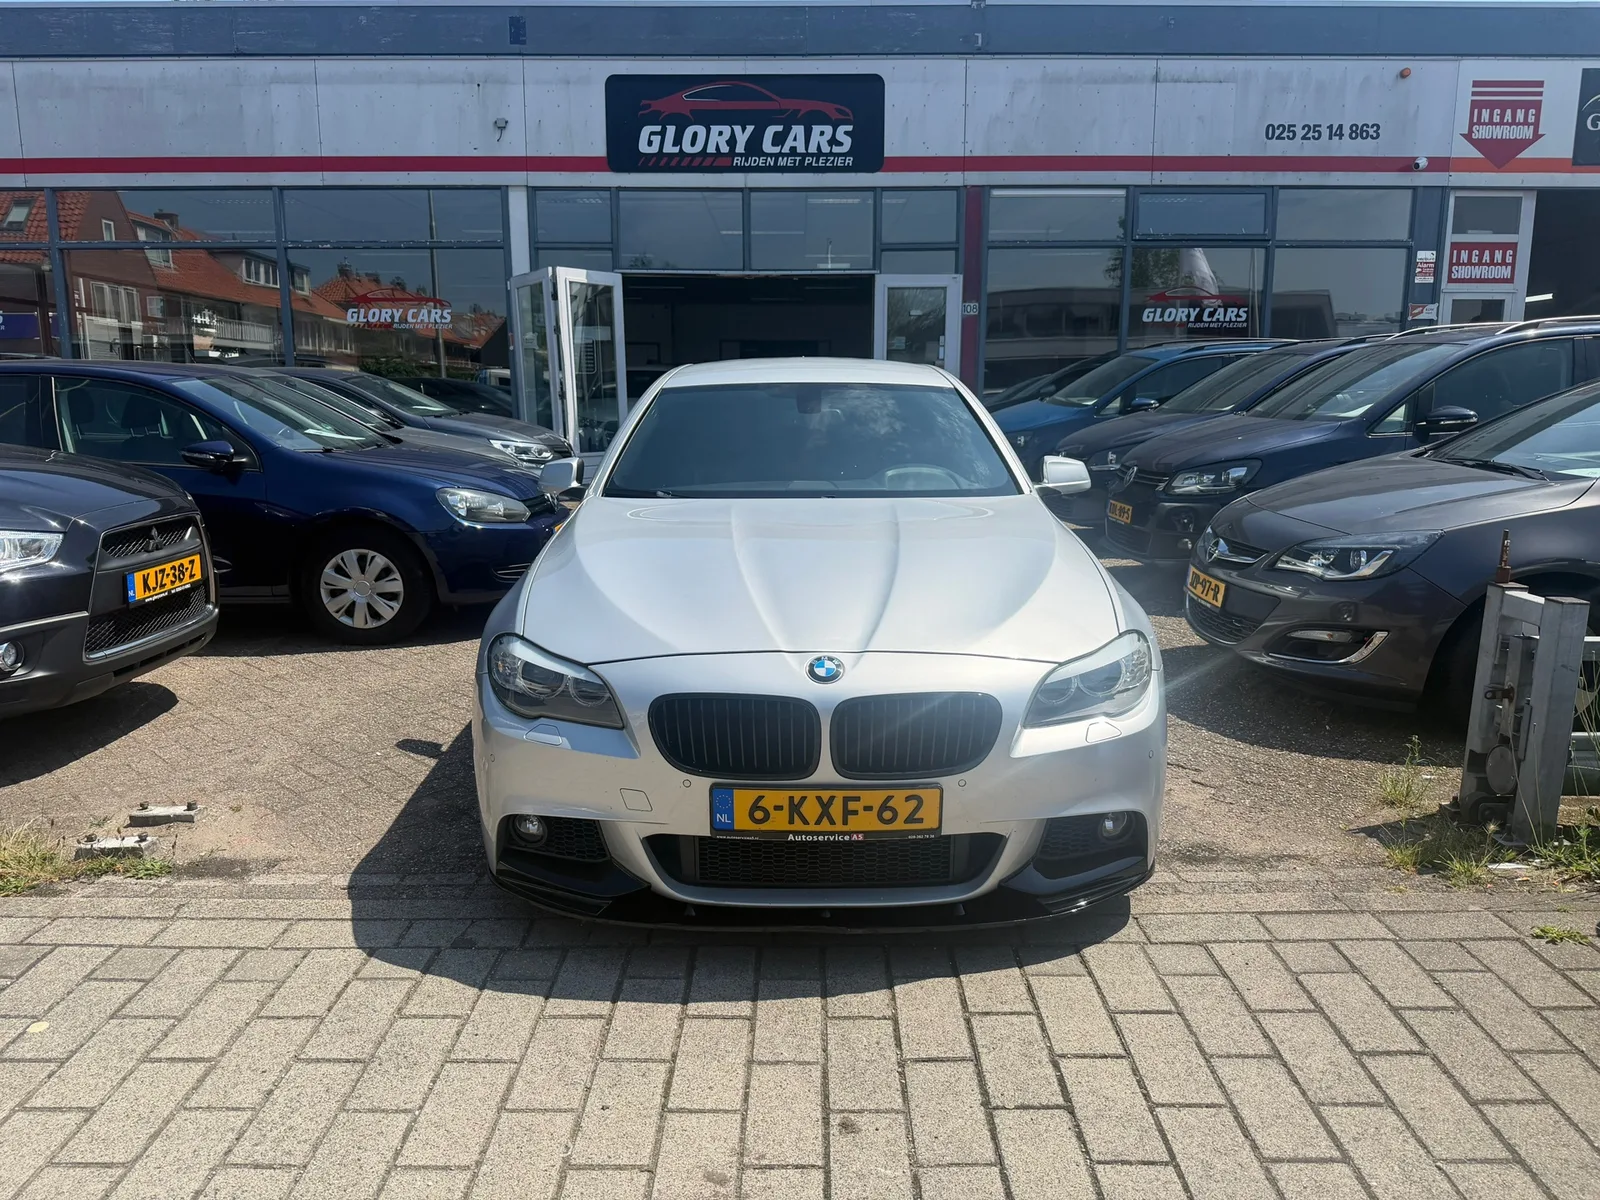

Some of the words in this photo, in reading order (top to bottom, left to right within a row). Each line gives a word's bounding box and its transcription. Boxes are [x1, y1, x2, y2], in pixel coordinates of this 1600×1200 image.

[1473, 108, 1536, 123] INGANG
[638, 124, 755, 154] GLORY
[762, 124, 854, 154] CARS
[1265, 123, 1297, 141] 025
[1300, 123, 1322, 141] 25
[1326, 123, 1345, 141] 14
[1348, 123, 1381, 141] 863
[1472, 125, 1534, 139] SHOWROOM
[733, 156, 777, 167] RIJDEN
[777, 156, 802, 167] MET
[805, 156, 854, 167] PLEZIER
[1452, 249, 1513, 263] INGANG
[1451, 265, 1511, 279] SHOWROOM
[346, 308, 403, 323] GLORY
[407, 308, 452, 323] CARS
[963, 304, 978, 313] 108
[1142, 307, 1200, 322] GLORY
[1202, 307, 1248, 322] CARS
[142, 559, 196, 595] KJZ-38-Z
[748, 794, 924, 826] 6-KXF-62
[716, 813, 731, 824] NL
[787, 833, 850, 842] Autoservice
